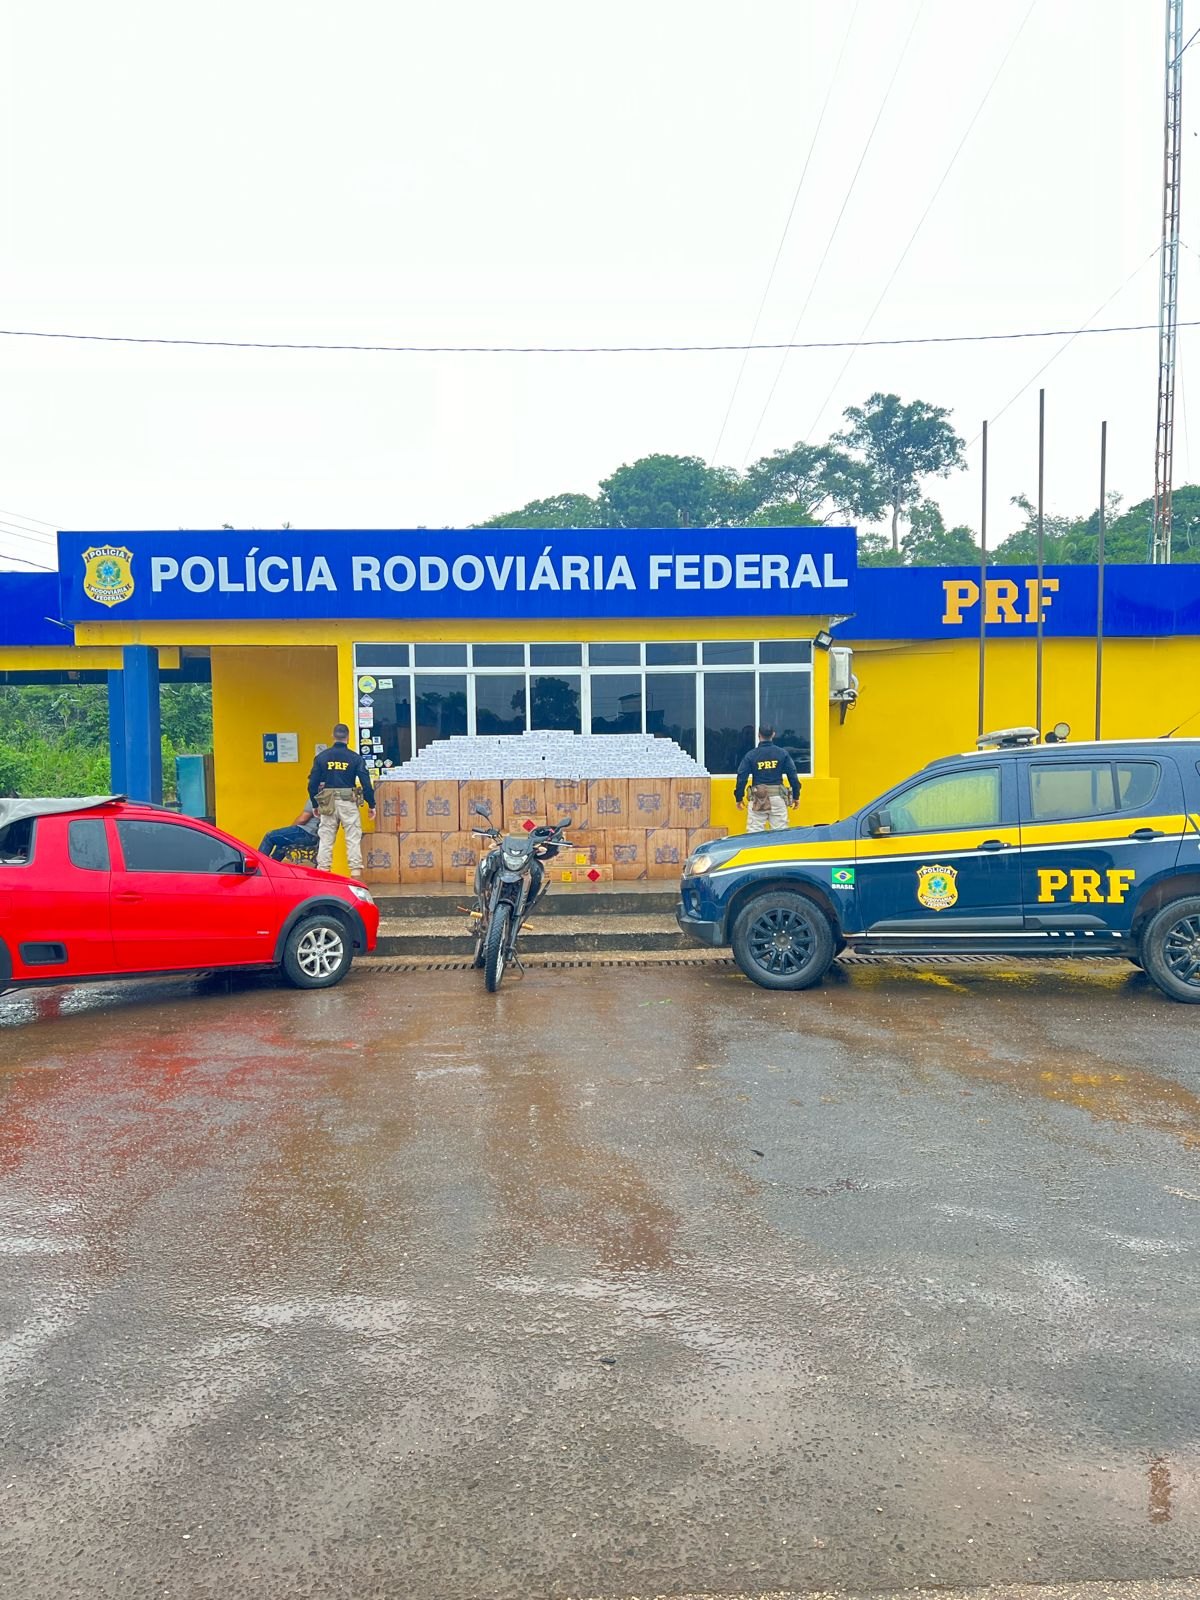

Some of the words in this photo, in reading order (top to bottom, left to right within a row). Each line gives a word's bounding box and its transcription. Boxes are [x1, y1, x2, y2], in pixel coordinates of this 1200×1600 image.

[150, 547, 337, 593] POLÍCIA
[351, 545, 636, 592] RODOVIÁRIA
[649, 553, 849, 591] FEDERAL
[942, 578, 1060, 624] PRF
[327, 761, 349, 771] PRF
[757, 760, 779, 770] PRF
[1037, 869, 1136, 904] PRF
